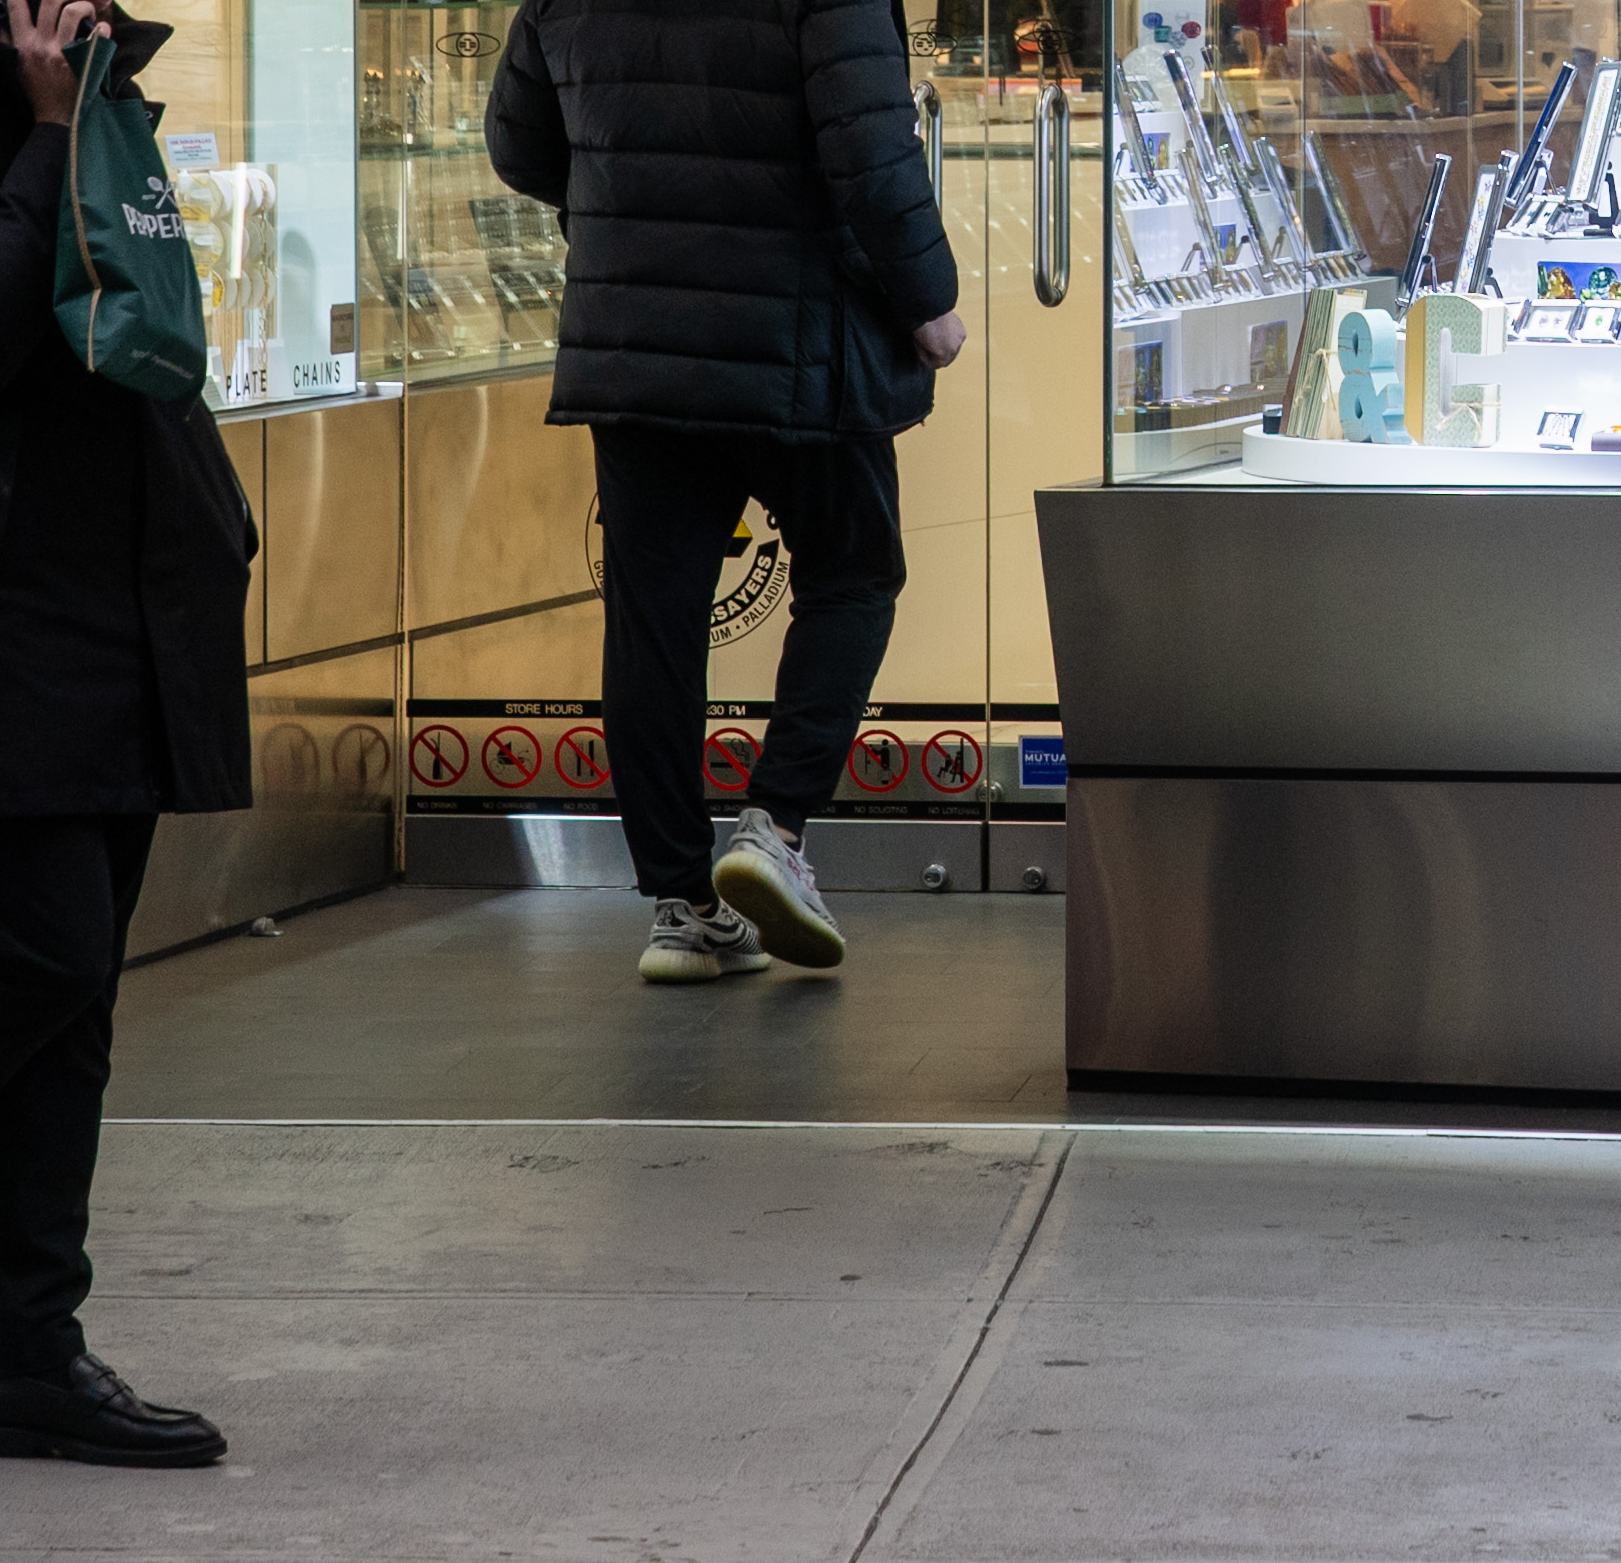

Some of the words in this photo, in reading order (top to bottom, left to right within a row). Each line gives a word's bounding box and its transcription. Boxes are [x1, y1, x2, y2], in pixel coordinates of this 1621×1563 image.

[293, 361, 342, 388] CHAINS
[226, 369, 267, 400] PLATE
[742, 561, 790, 628] PALLADIUM
[505, 703, 541, 715] STORE
[545, 703, 584, 716] HOURS
[728, 705, 746, 716] PM
[577, 803, 598, 811] FOOD
[854, 805, 867, 813] NO
[928, 806, 940, 814] NO
